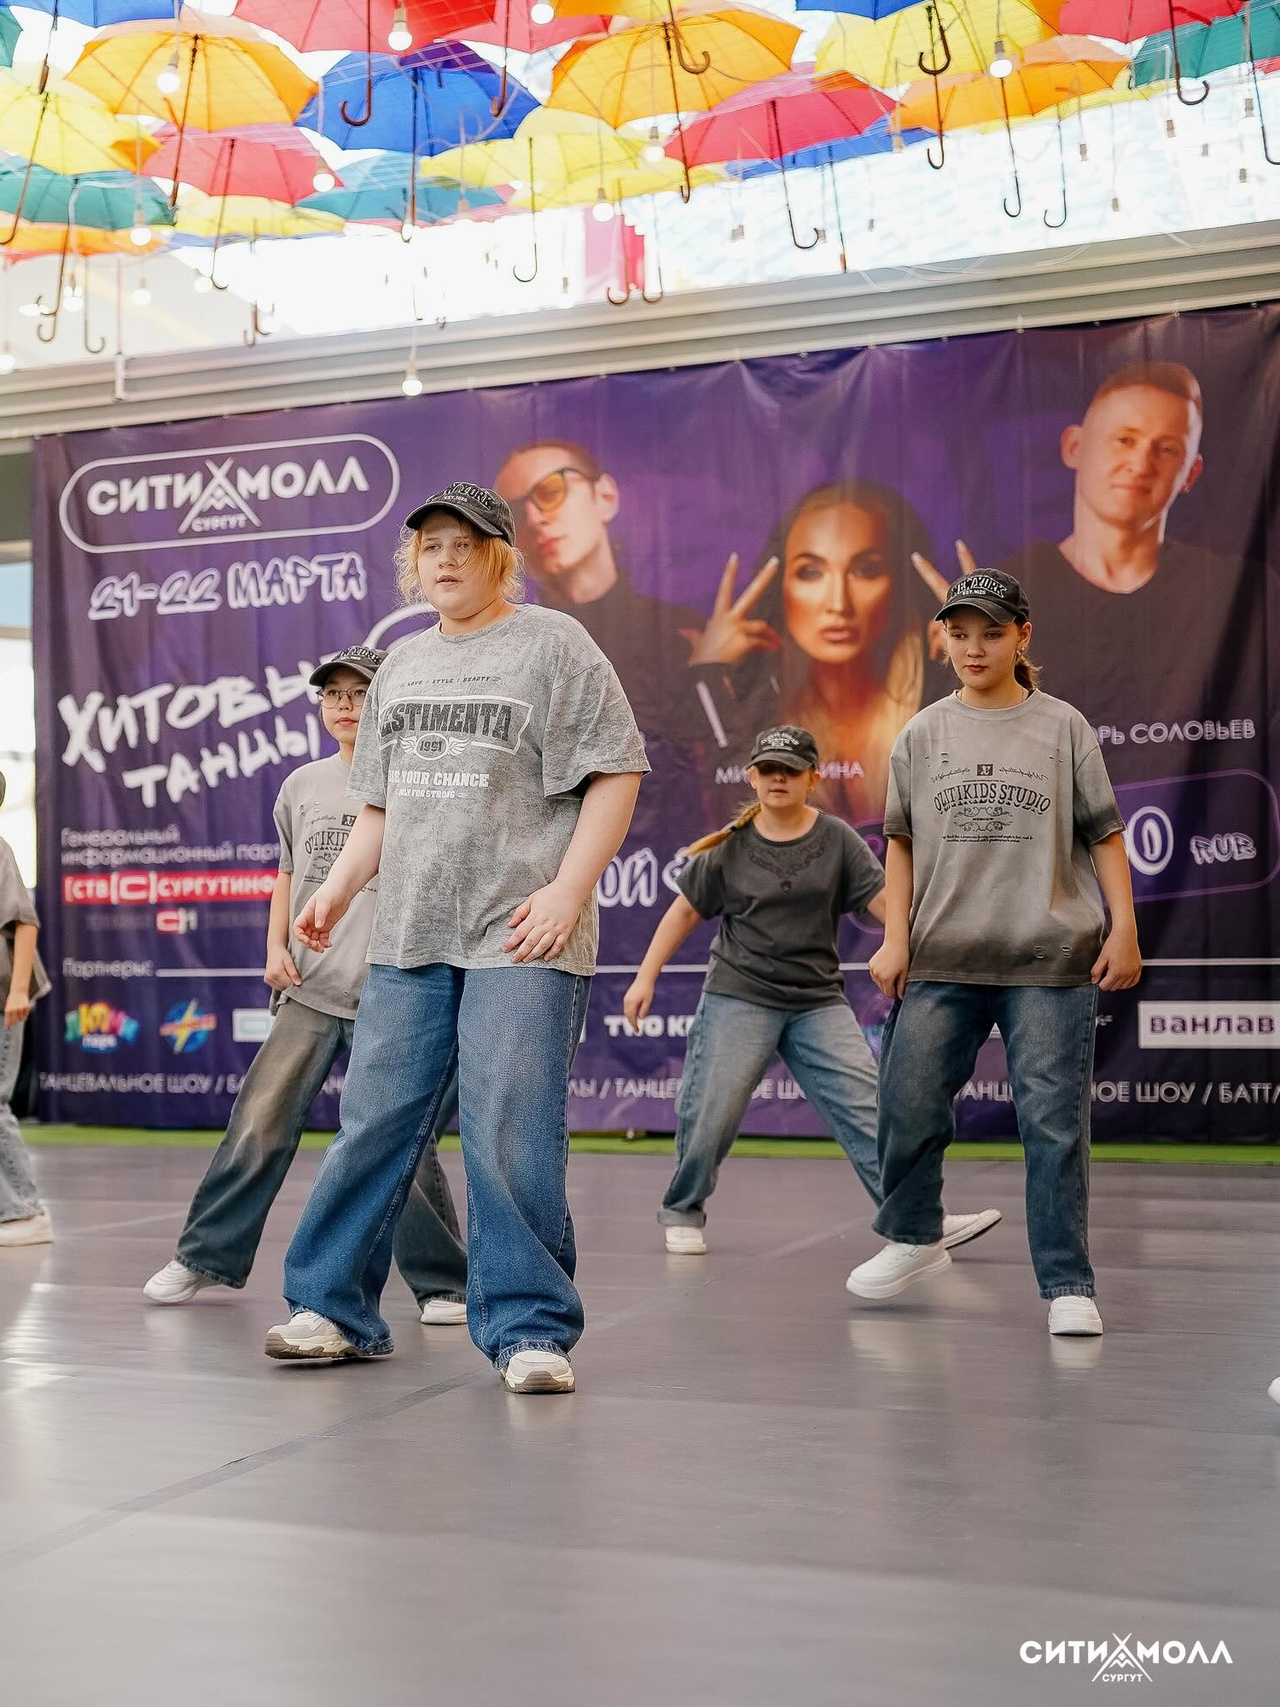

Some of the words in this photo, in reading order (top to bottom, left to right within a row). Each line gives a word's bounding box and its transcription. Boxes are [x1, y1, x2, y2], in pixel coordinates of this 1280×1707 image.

[87, 471, 202, 516] СИТИ
[236, 456, 370, 501] МОЛЛ
[191, 514, 248, 533] СУРГУТ
[87, 567, 221, 621] 21-22
[227, 551, 367, 610] МАРТА
[57, 660, 326, 774] ХИТОВЫ
[381, 703, 512, 742] ESTIMENTA
[1129, 718, 1256, 745] СОЛОВЬЕВ
[122, 713, 320, 809] ТАНЦЫ
[401, 770, 431, 785] YOUR
[433, 772, 490, 788] CHANCE
[999, 783, 1051, 814] STUDIO
[236, 843, 282, 864] парт
[157, 874, 278, 898] СУРГУТИНФ
[1150, 1014, 1275, 1036] ванлав
[166, 1073, 213, 1095] ШОУ
[1135, 1081, 1196, 1104] ШОУ
